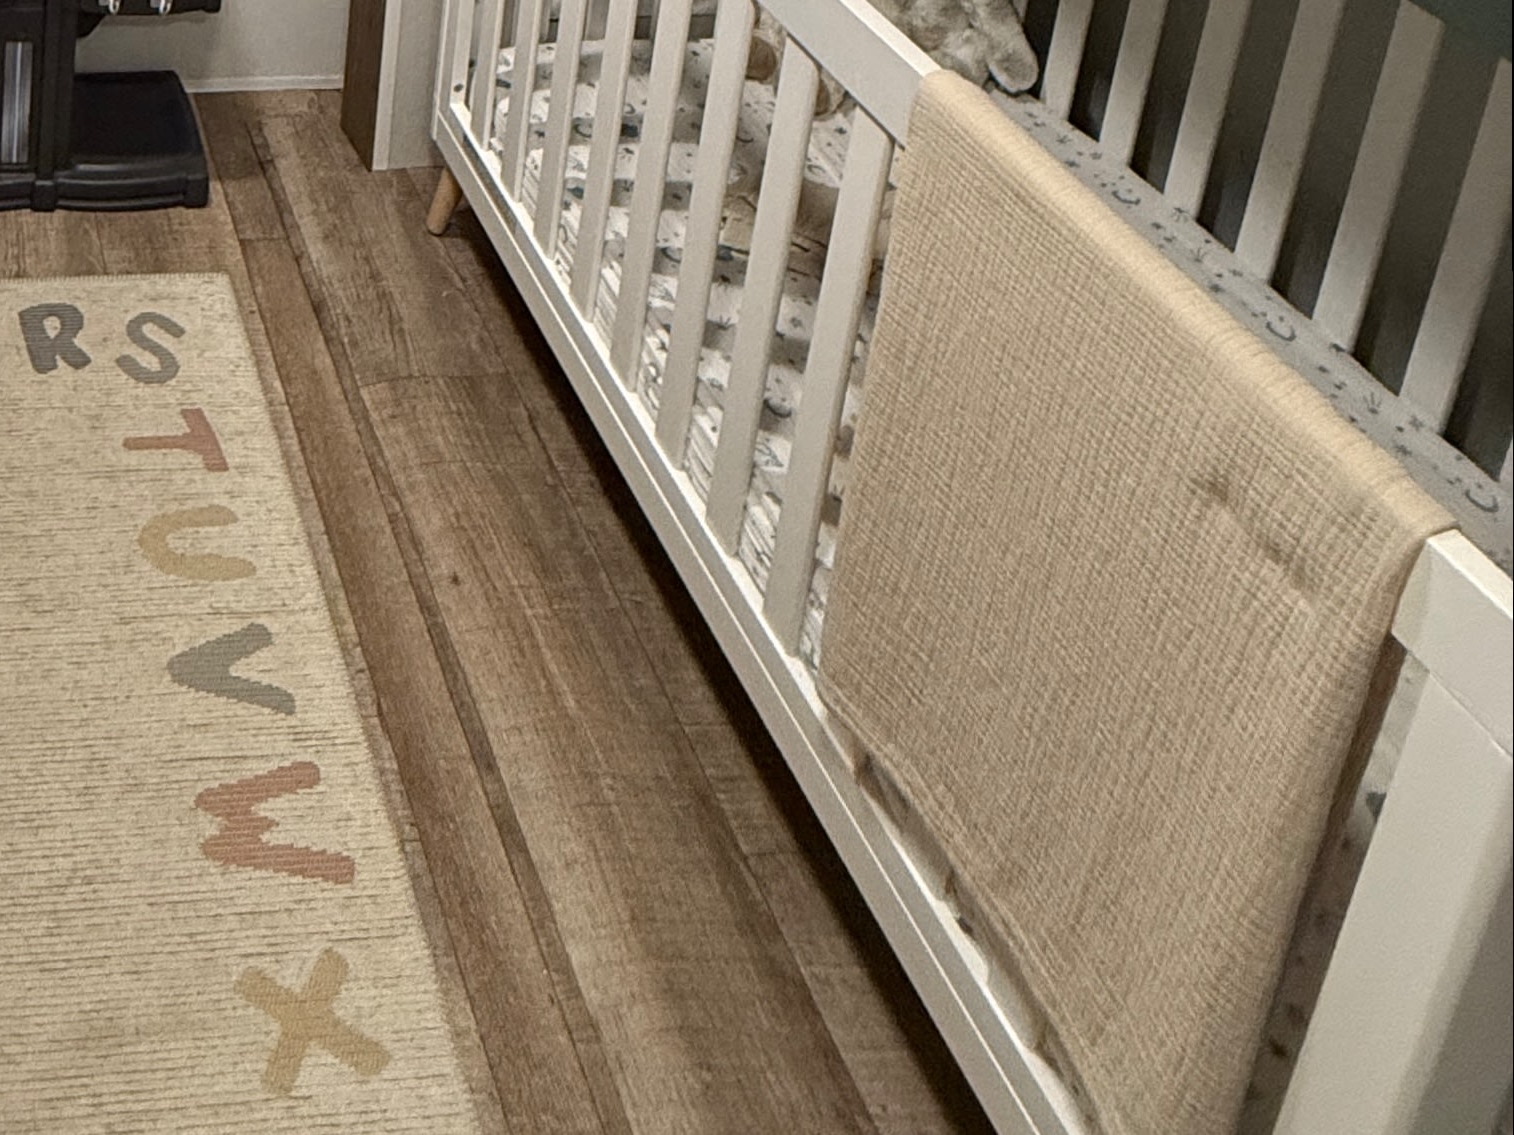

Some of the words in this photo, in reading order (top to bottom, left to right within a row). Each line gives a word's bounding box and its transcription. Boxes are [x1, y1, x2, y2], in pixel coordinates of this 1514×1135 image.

[18, 303, 93, 373] R
[115, 312, 185, 384] S
[122, 409, 228, 472] T
[137, 506, 257, 581] U
[167, 623, 296, 716] V
[194, 762, 354, 884] W
[233, 947, 392, 1097] X
